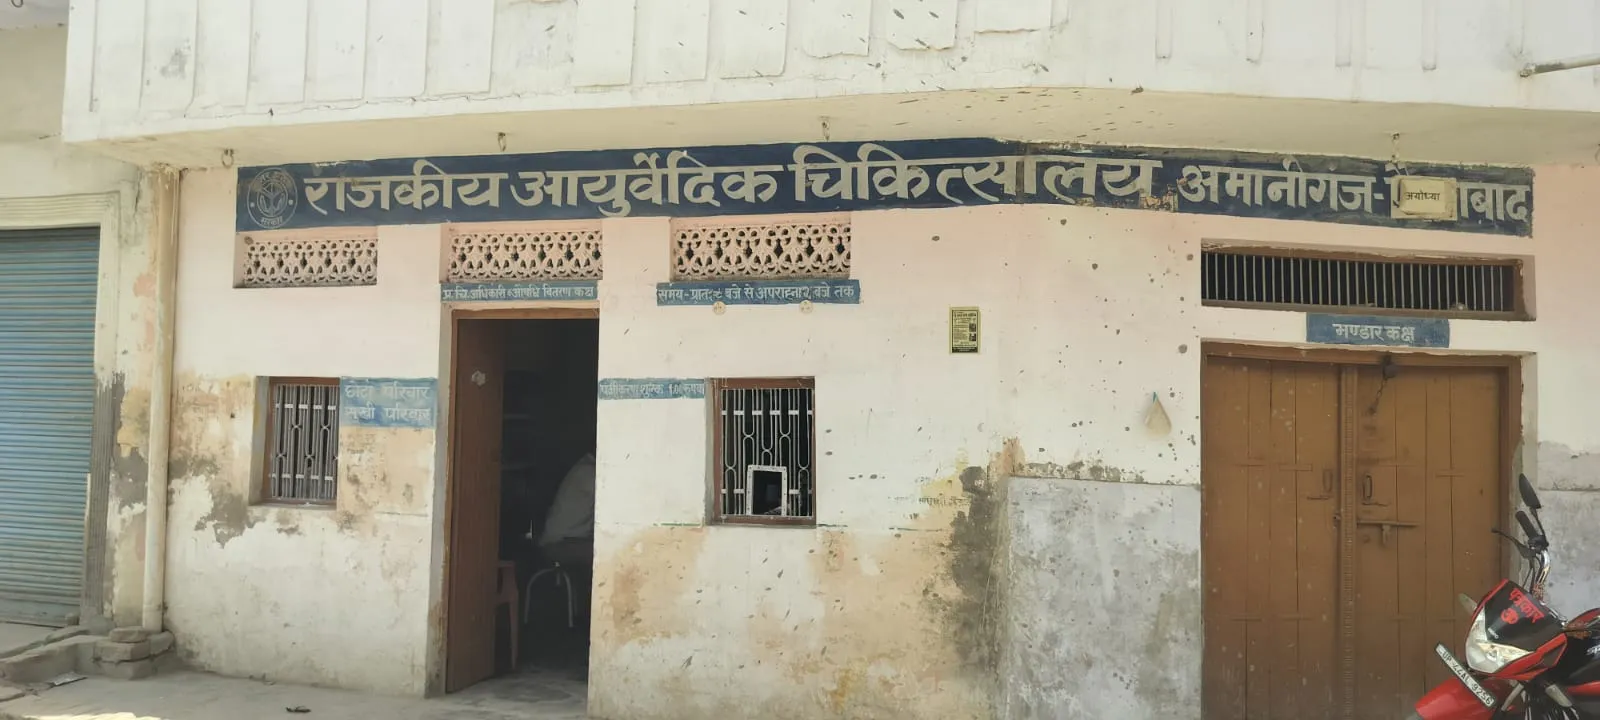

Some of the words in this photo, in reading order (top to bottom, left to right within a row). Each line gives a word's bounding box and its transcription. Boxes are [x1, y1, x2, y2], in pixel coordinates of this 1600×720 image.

[303, 158, 509, 216] राजकीय
[510, 149, 784, 217] आयुर्वेदिक
[787, 142, 1163, 205] चिकित्सालय
[1404, 188, 1441, 200] अयोध्या
[834, 285, 855, 298] तक
[1384, 325, 1415, 342] कक्ष
[1442, 651, 1452, 662] UP
